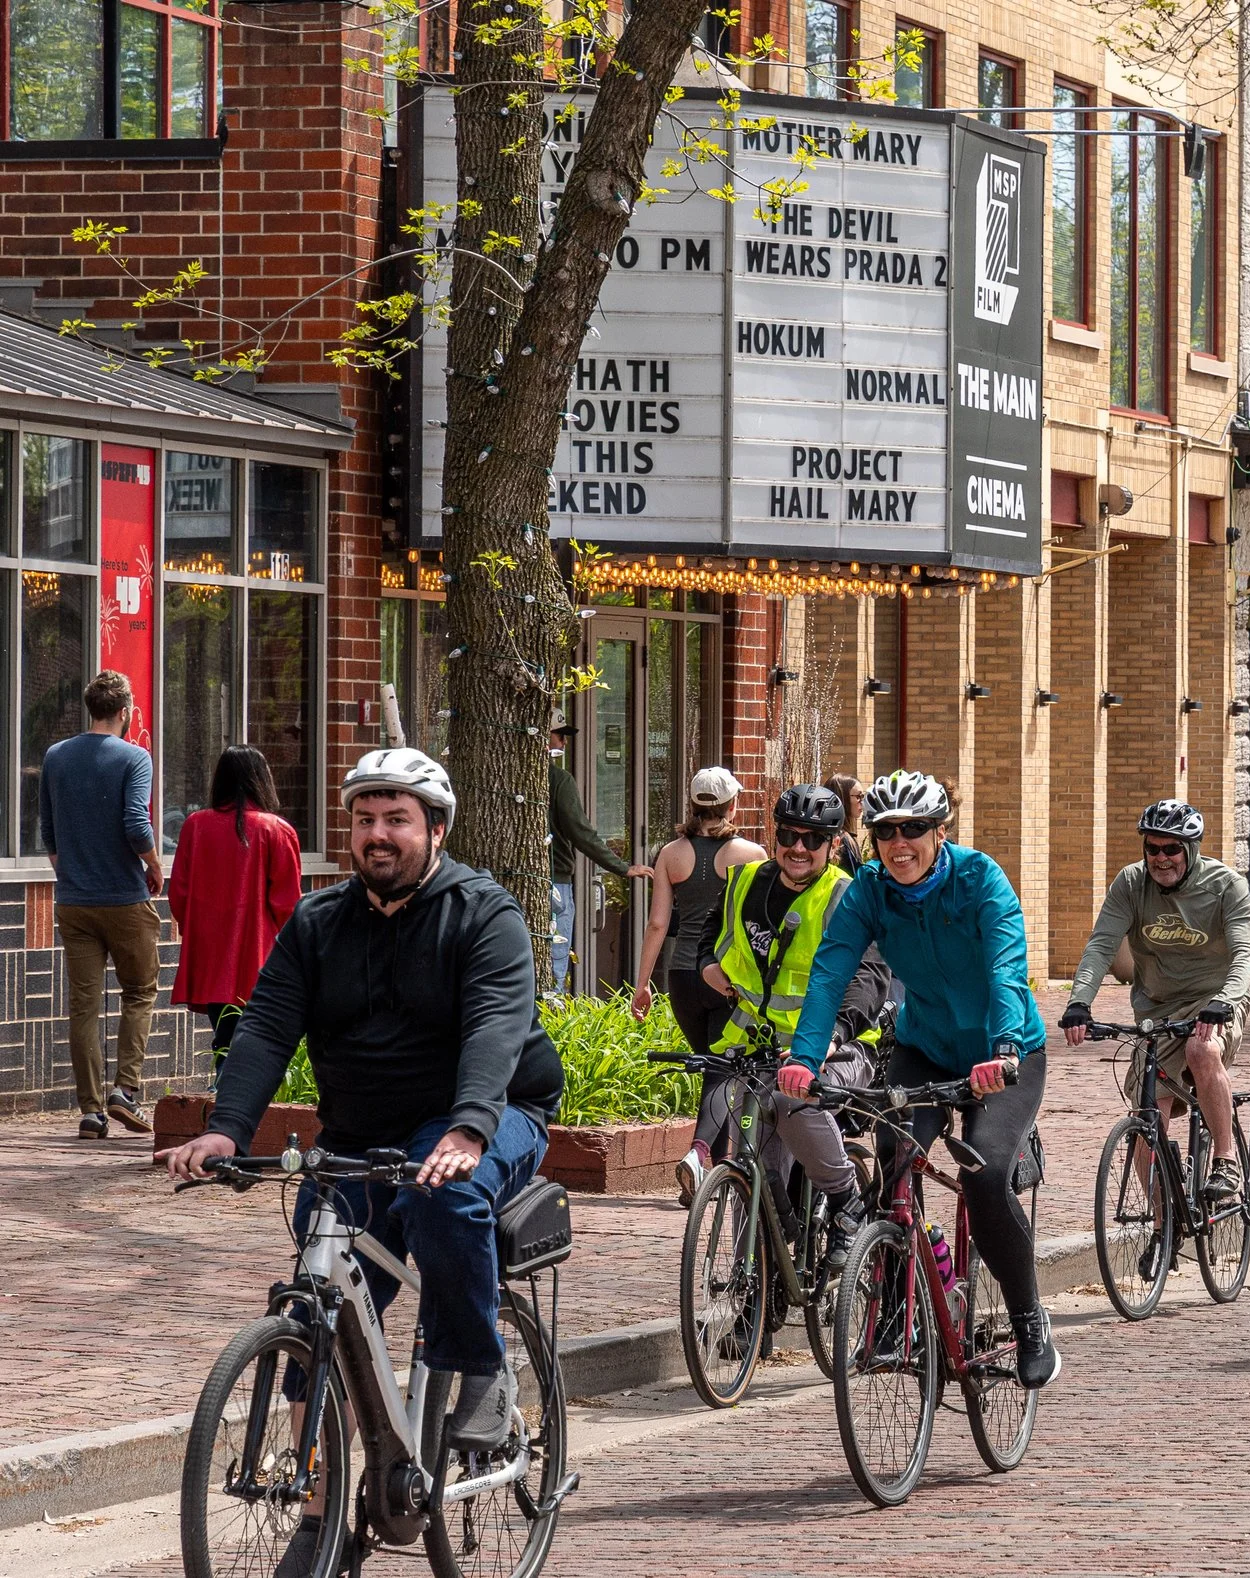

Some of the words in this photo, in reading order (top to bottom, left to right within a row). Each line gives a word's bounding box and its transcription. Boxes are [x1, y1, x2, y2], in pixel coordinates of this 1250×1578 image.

[742, 117, 843, 159] MOTHER
[853, 130, 922, 166] MARY
[993, 168, 1017, 198] MSP
[768, 203, 813, 237] THE
[828, 207, 898, 244] DEVIL
[661, 238, 711, 271] PM
[745, 240, 831, 279] WEARS
[844, 248, 923, 286] PRADA
[934, 255, 947, 288] 2
[977, 286, 1001, 314] FILM
[737, 321, 825, 359] HOKUM
[846, 368, 945, 405] NORMAL
[957, 362, 990, 411] THE
[993, 370, 1037, 421] MAIN
[572, 440, 654, 475] THIS
[792, 446, 903, 482] PROJECT
[770, 485, 829, 520] HAIL
[847, 488, 917, 522] MARY
[966, 474, 1026, 521] CINEMA
[116, 575, 141, 615] 45
[1148, 926, 1201, 946] Berkley
[520, 1228, 569, 1261] TOPEAK
[363, 1290, 377, 1328] YAMAHA
